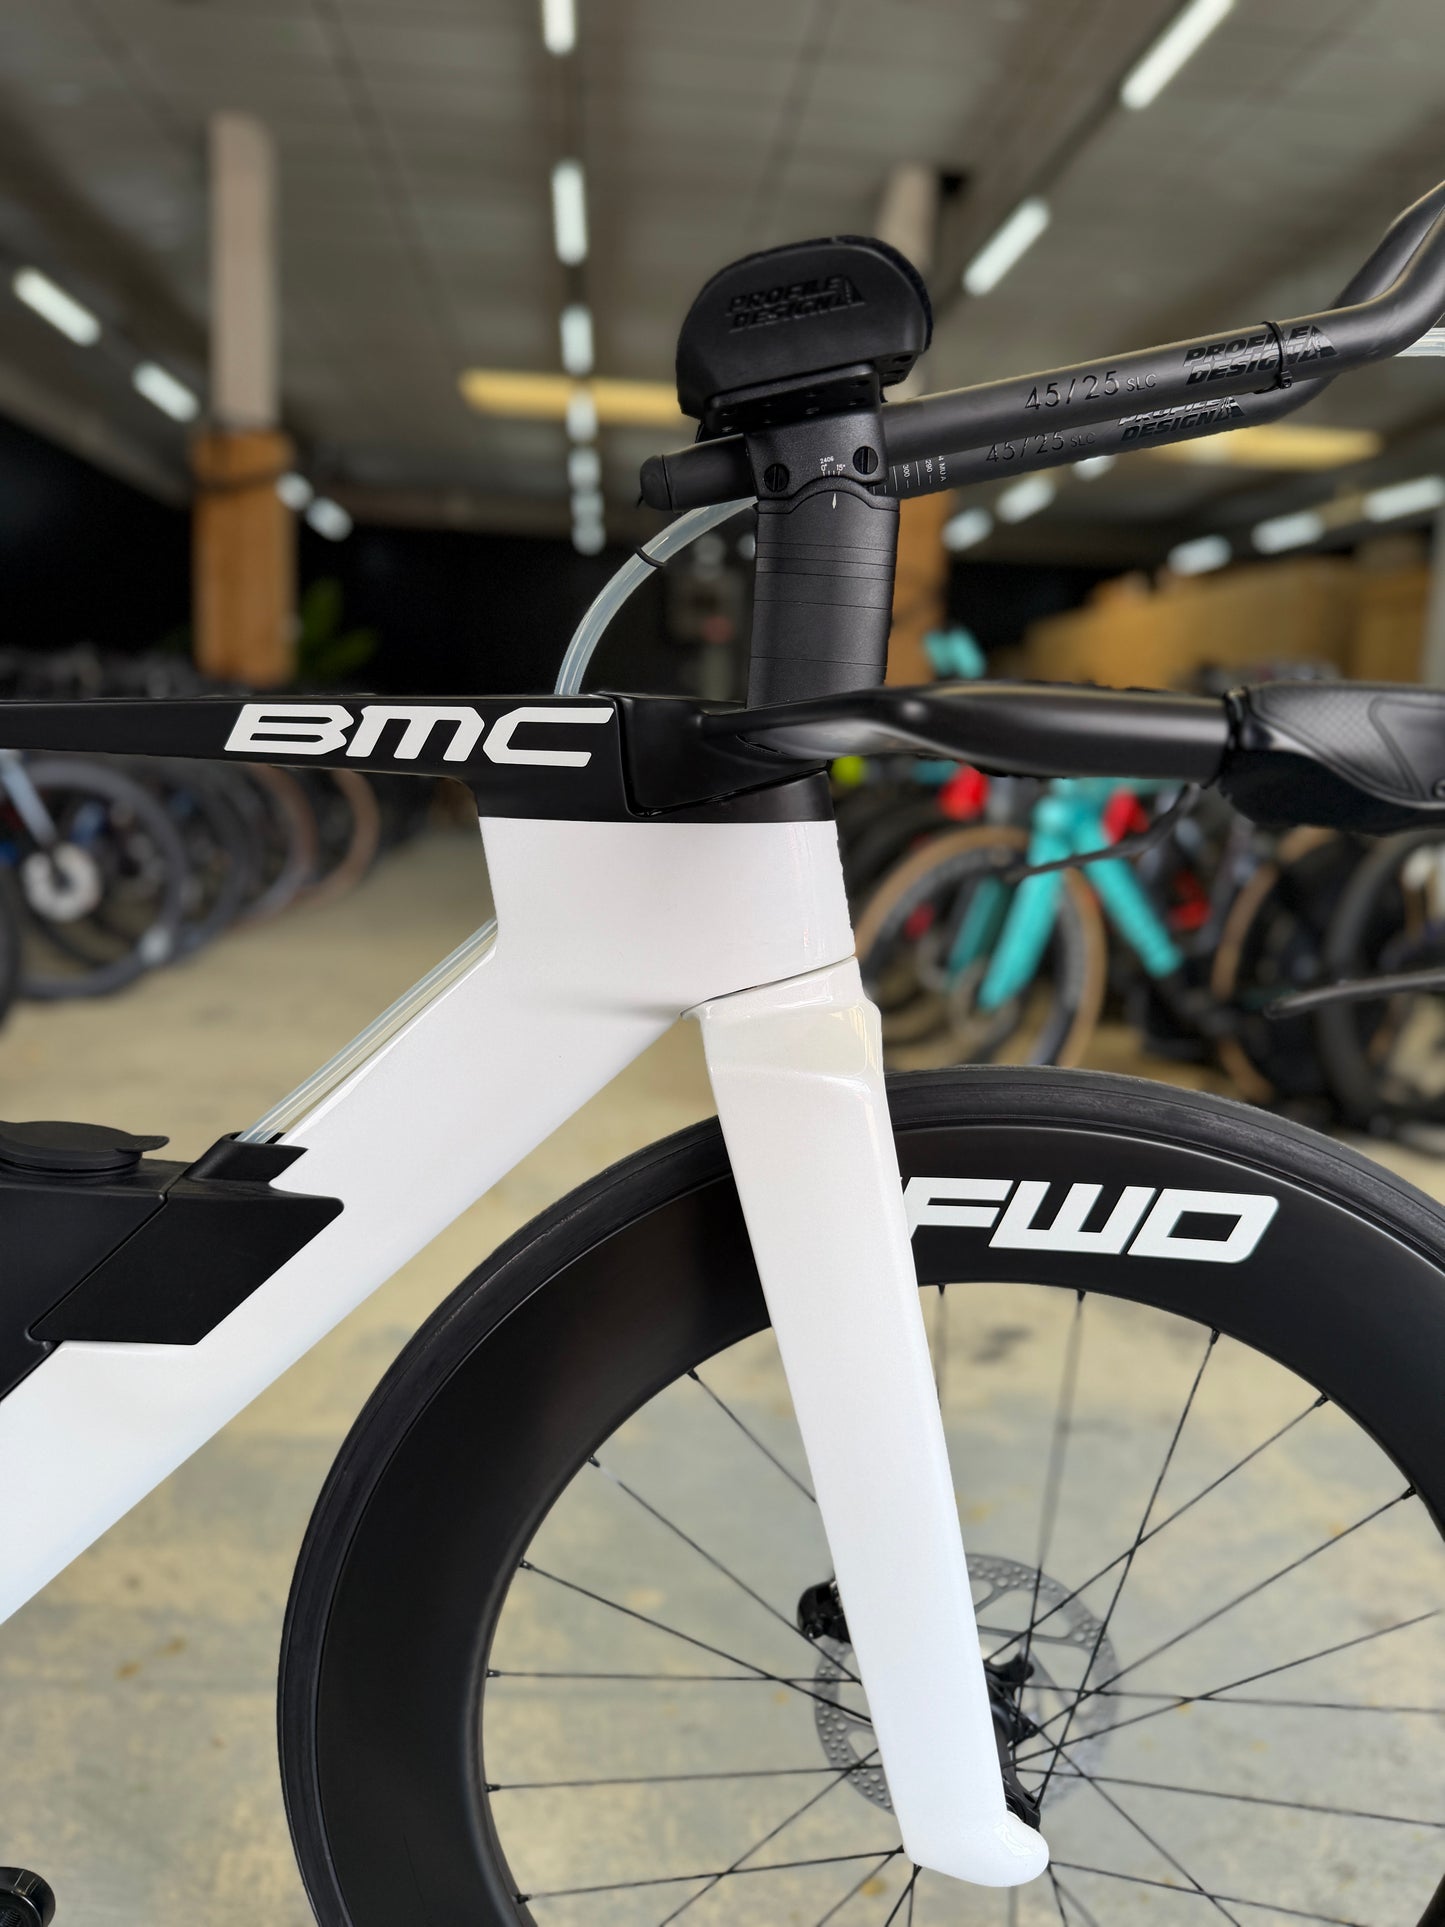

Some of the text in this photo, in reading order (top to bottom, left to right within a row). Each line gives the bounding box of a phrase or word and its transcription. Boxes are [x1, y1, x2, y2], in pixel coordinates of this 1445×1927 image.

[727, 273, 844, 313] PROFILE
[729, 294, 833, 332] DESIGN
[1183, 325, 1309, 367] PROFIE
[1025, 370, 1157, 410] 45/25 SLC
[1120, 408, 1219, 441] DESIGN
[986, 431, 1097, 462] 45/25 SLC
[902, 464, 911, 478] 300
[224, 704, 615, 767] BMC
[900, 1176, 1279, 1263] FWD
